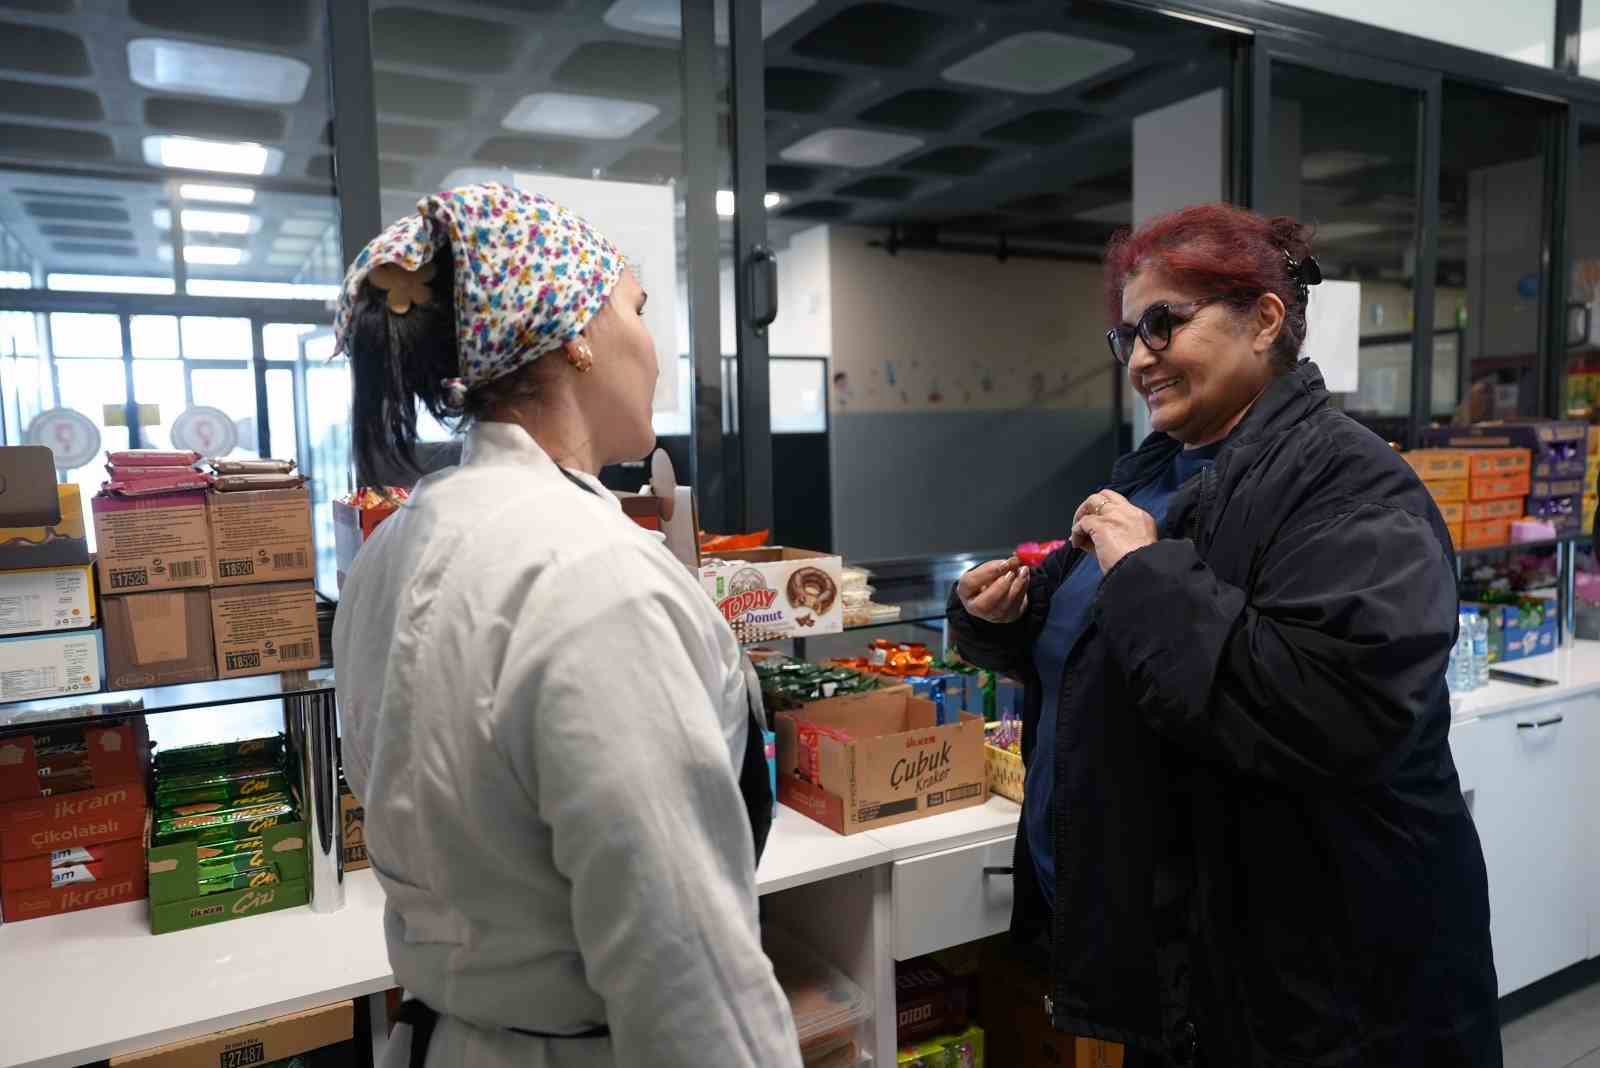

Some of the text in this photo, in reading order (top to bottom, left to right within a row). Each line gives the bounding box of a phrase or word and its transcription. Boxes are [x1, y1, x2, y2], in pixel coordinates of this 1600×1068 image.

[720, 590, 777, 620] TODAY
[745, 611, 785, 624] Donut
[889, 739, 953, 791] Çubuk
[914, 767, 952, 793] Kraker
[55, 790, 128, 819] ikram
[31, 820, 120, 849] Çikolatalı
[60, 882, 133, 910] ikram
